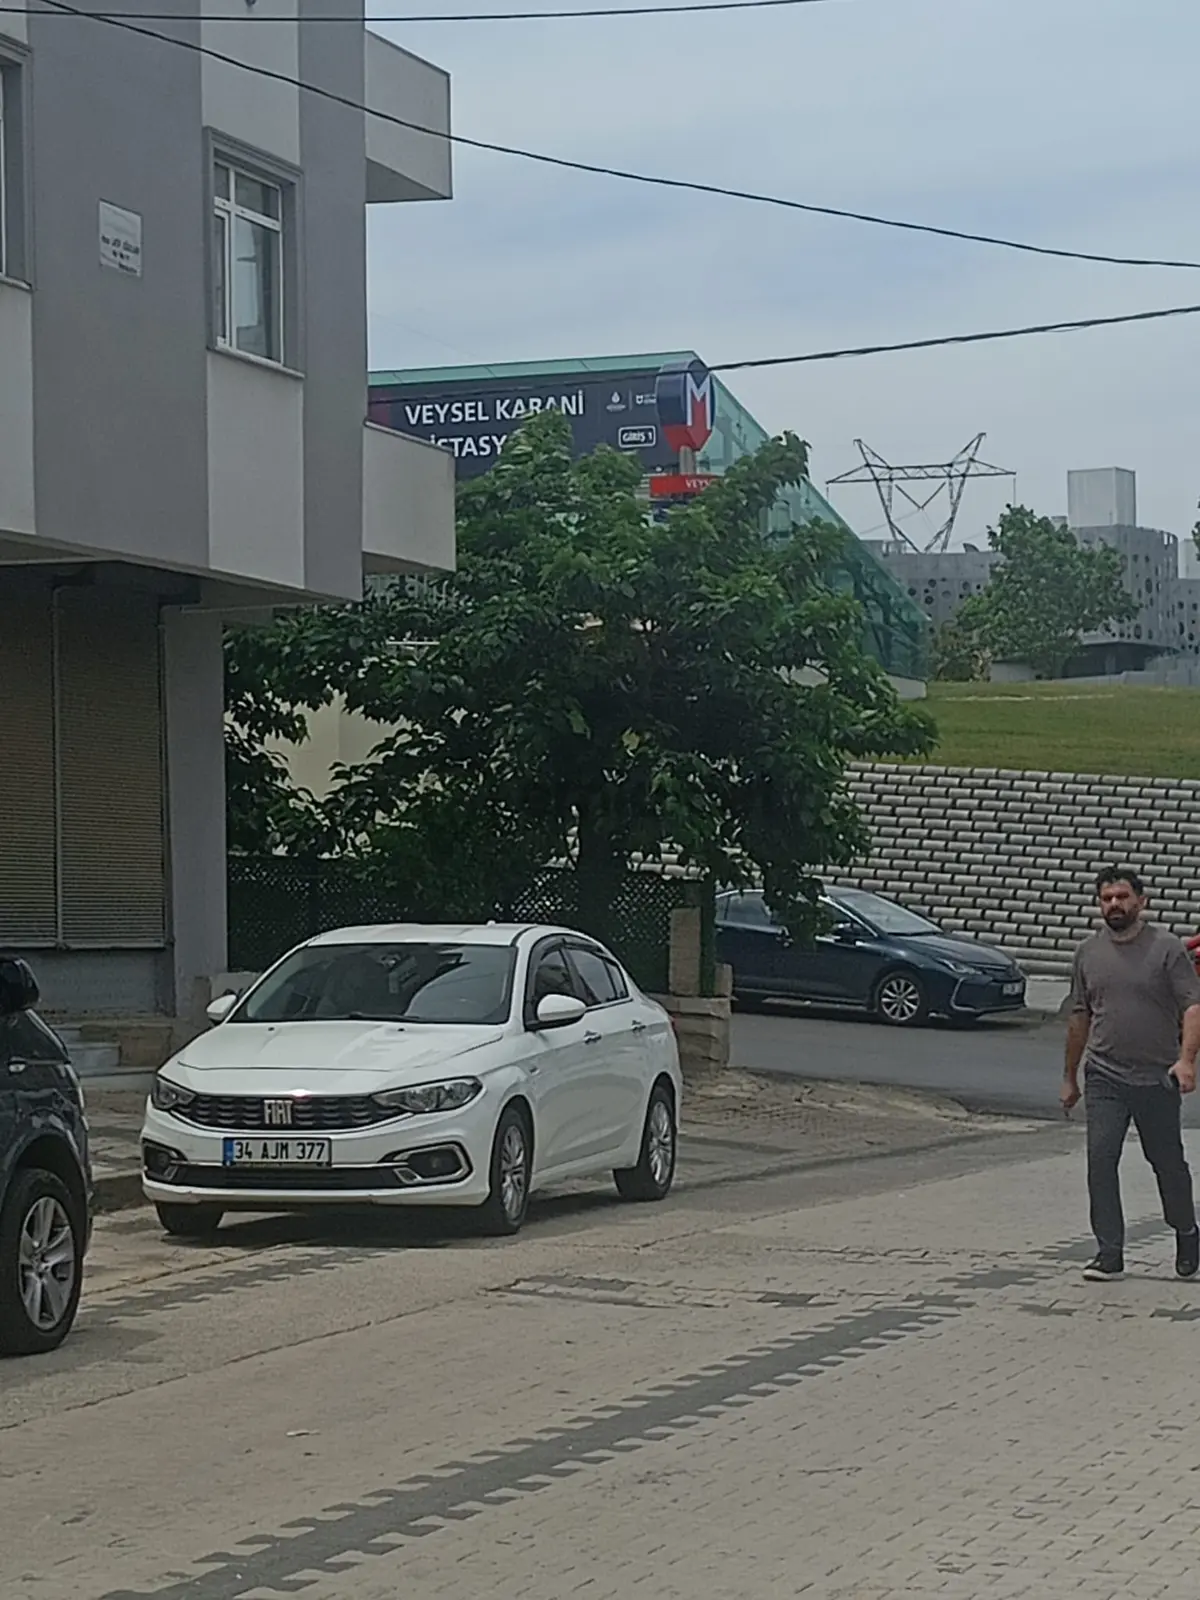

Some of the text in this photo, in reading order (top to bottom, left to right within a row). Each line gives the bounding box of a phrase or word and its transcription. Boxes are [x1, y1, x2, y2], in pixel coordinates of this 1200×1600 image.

[405, 389, 584, 425] VEYSEL KARANİ
[264, 1100, 293, 1124] FIAT
[235, 1142, 325, 1159] 34 AJM 377
